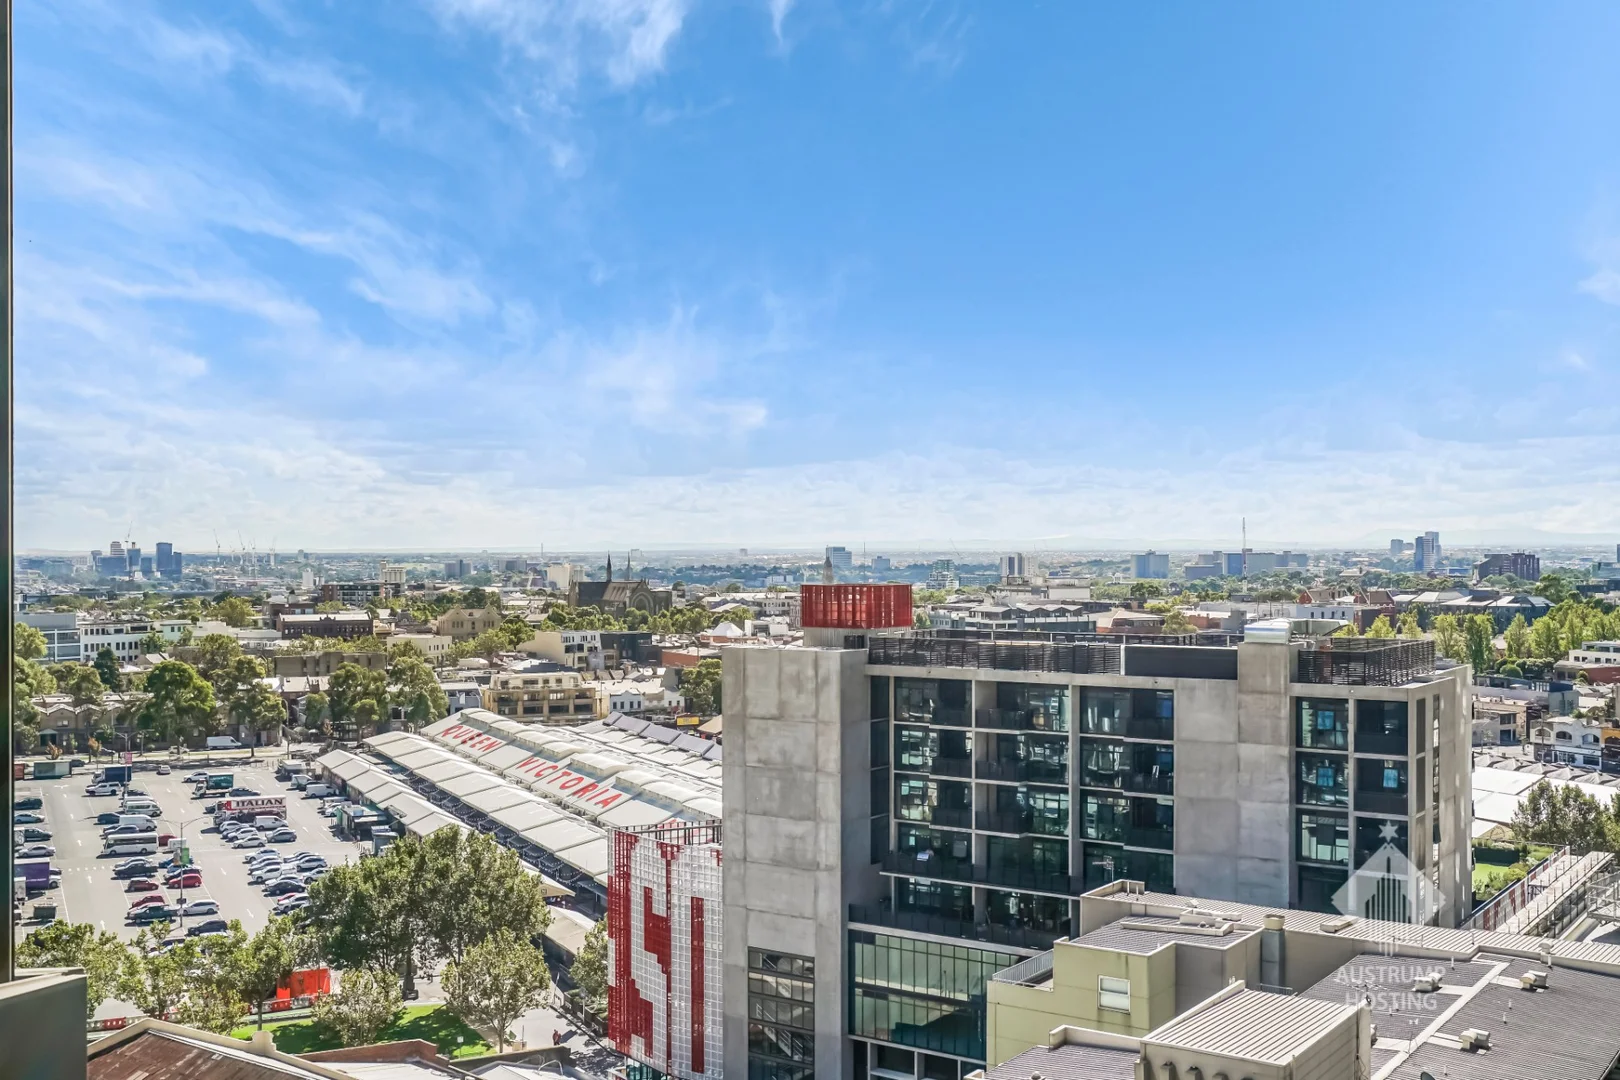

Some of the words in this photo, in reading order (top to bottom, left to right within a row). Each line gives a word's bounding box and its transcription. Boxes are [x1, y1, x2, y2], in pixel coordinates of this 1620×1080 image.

[442, 724, 502, 752] QUEEN
[516, 756, 622, 809] VICTORIA
[236, 799, 283, 807] ITALIAN
